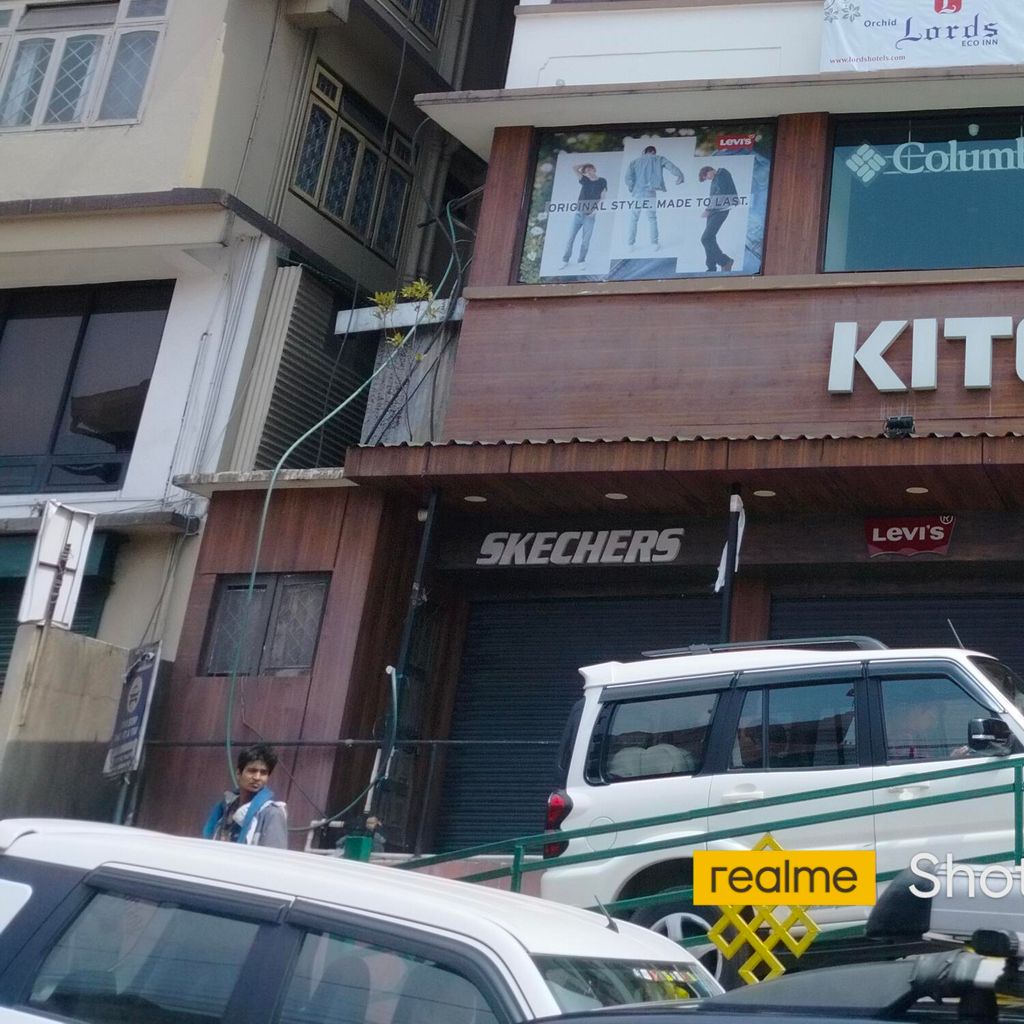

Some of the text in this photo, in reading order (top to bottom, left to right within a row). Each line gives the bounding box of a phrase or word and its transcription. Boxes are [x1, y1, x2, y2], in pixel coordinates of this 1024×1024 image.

[863, 13, 999, 50] Orchid Lords
[829, 54, 906, 64] www.lordshotels.com
[549, 196, 748, 213] ORIGINAL STYLE. MADE TO LAST.
[476, 528, 685, 565] SKECHERS
